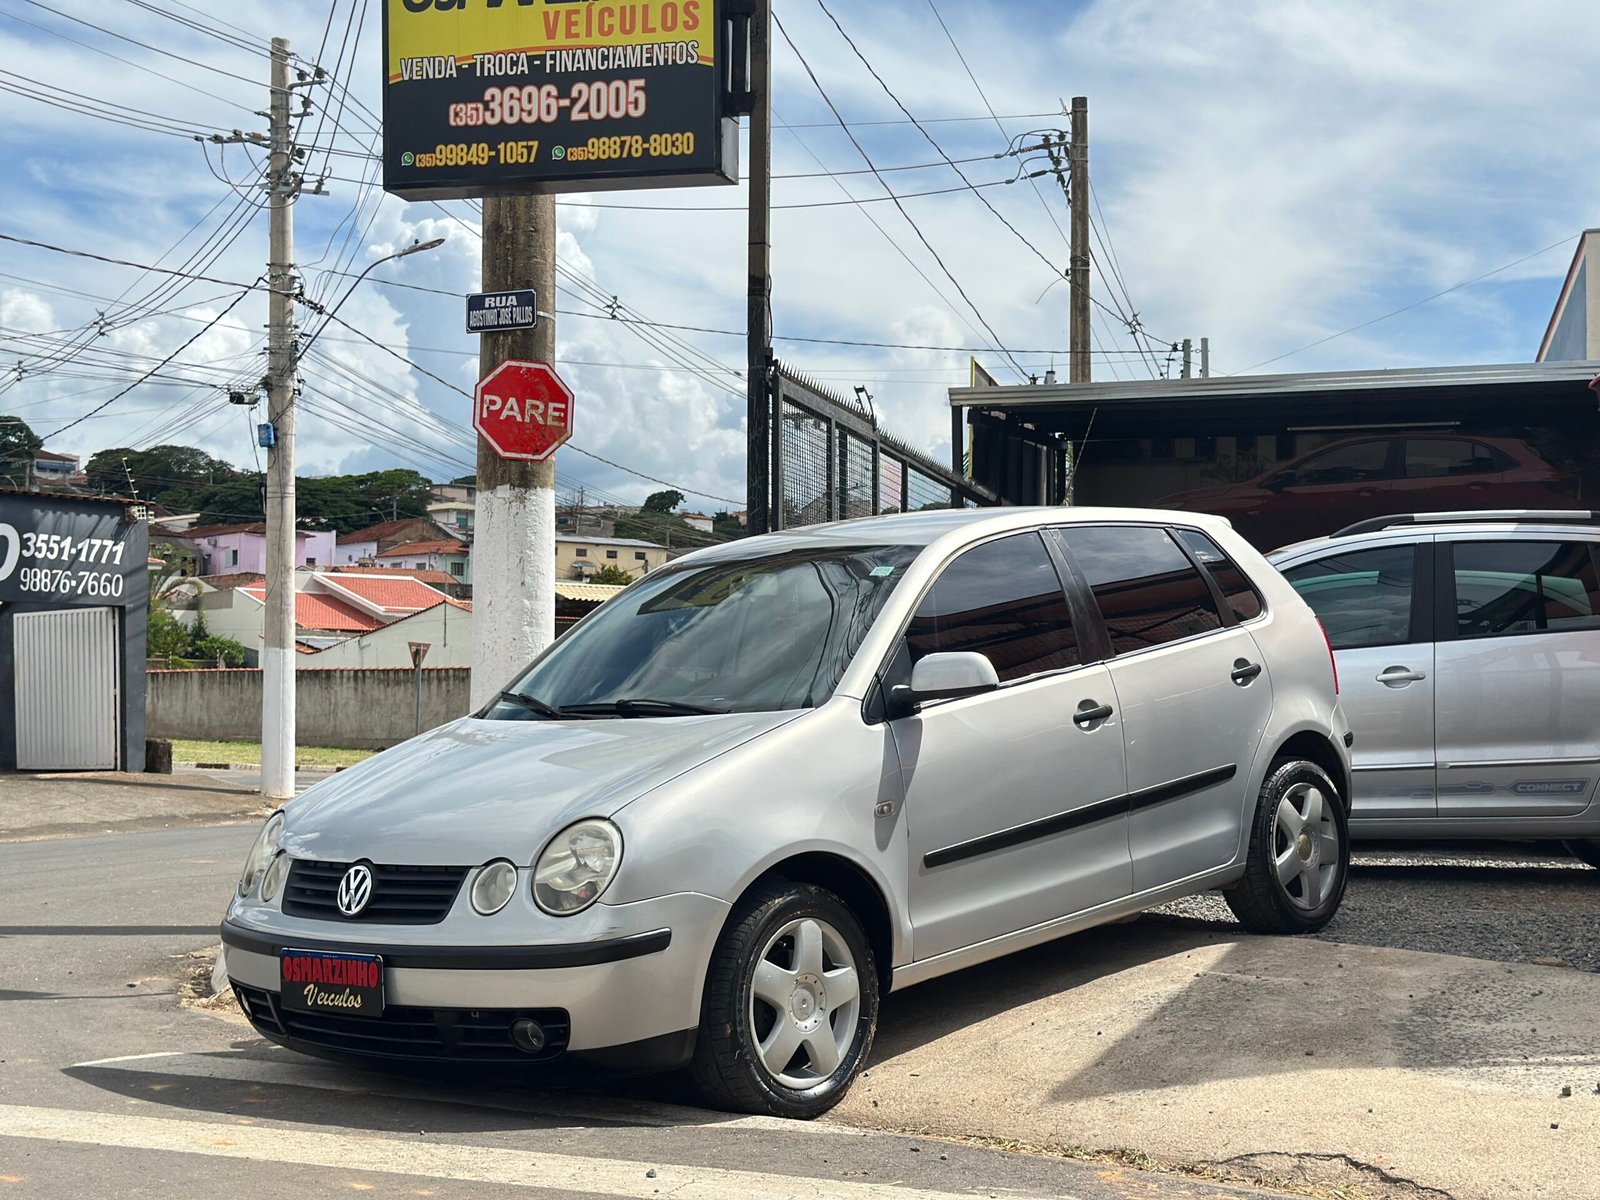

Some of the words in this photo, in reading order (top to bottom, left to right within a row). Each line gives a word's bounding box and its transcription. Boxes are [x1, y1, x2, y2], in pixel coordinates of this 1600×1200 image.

[543, 1, 700, 40] VEÍCULOS
[400, 56, 457, 81] VENDA
[473, 51, 529, 77] TROCA
[545, 41, 700, 74] FINANCIAMENTOS
[469, 308, 498, 327] AGOSTINHO
[484, 295, 518, 308] RUA
[482, 394, 566, 427] PARE
[1516, 783, 1581, 792] CONNECT
[283, 956, 379, 989] OSMARZINHO
